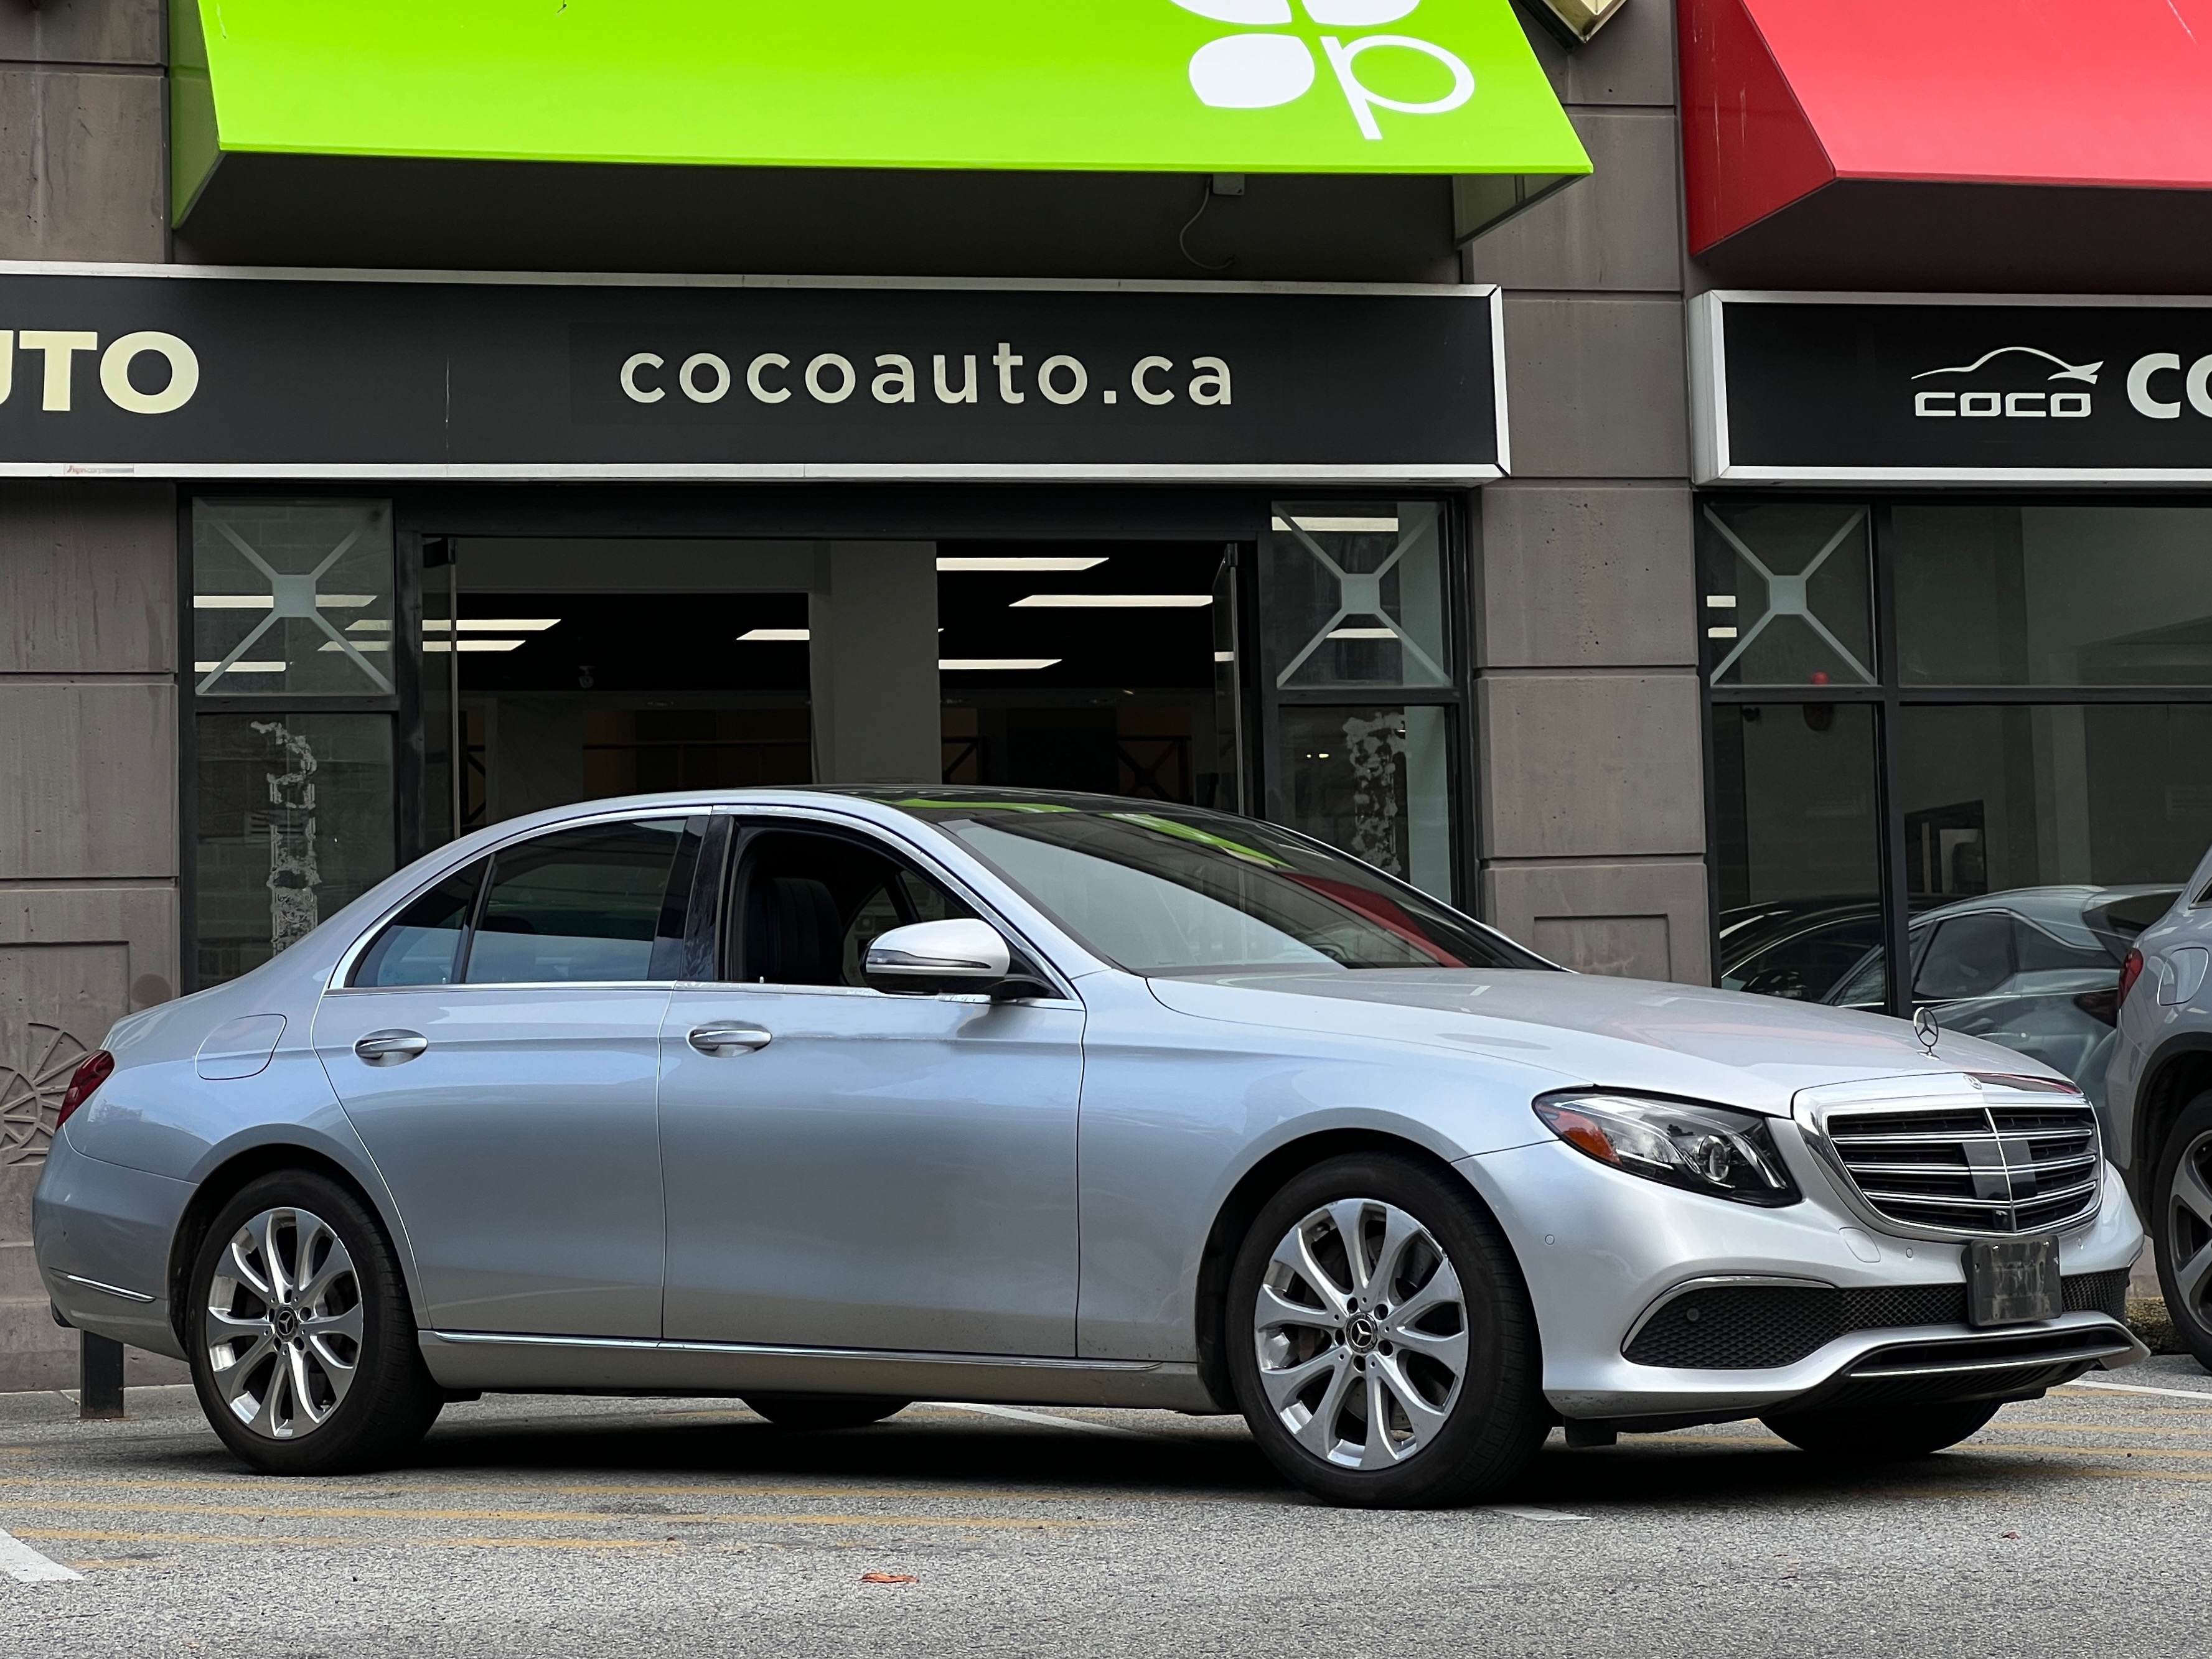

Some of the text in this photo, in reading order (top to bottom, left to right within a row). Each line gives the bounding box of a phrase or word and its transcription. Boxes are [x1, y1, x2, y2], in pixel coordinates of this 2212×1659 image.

[0, 330, 199, 414] TO
[620, 342, 1232, 406] cocoauto.ca
[1914, 392, 2091, 418] COCO
